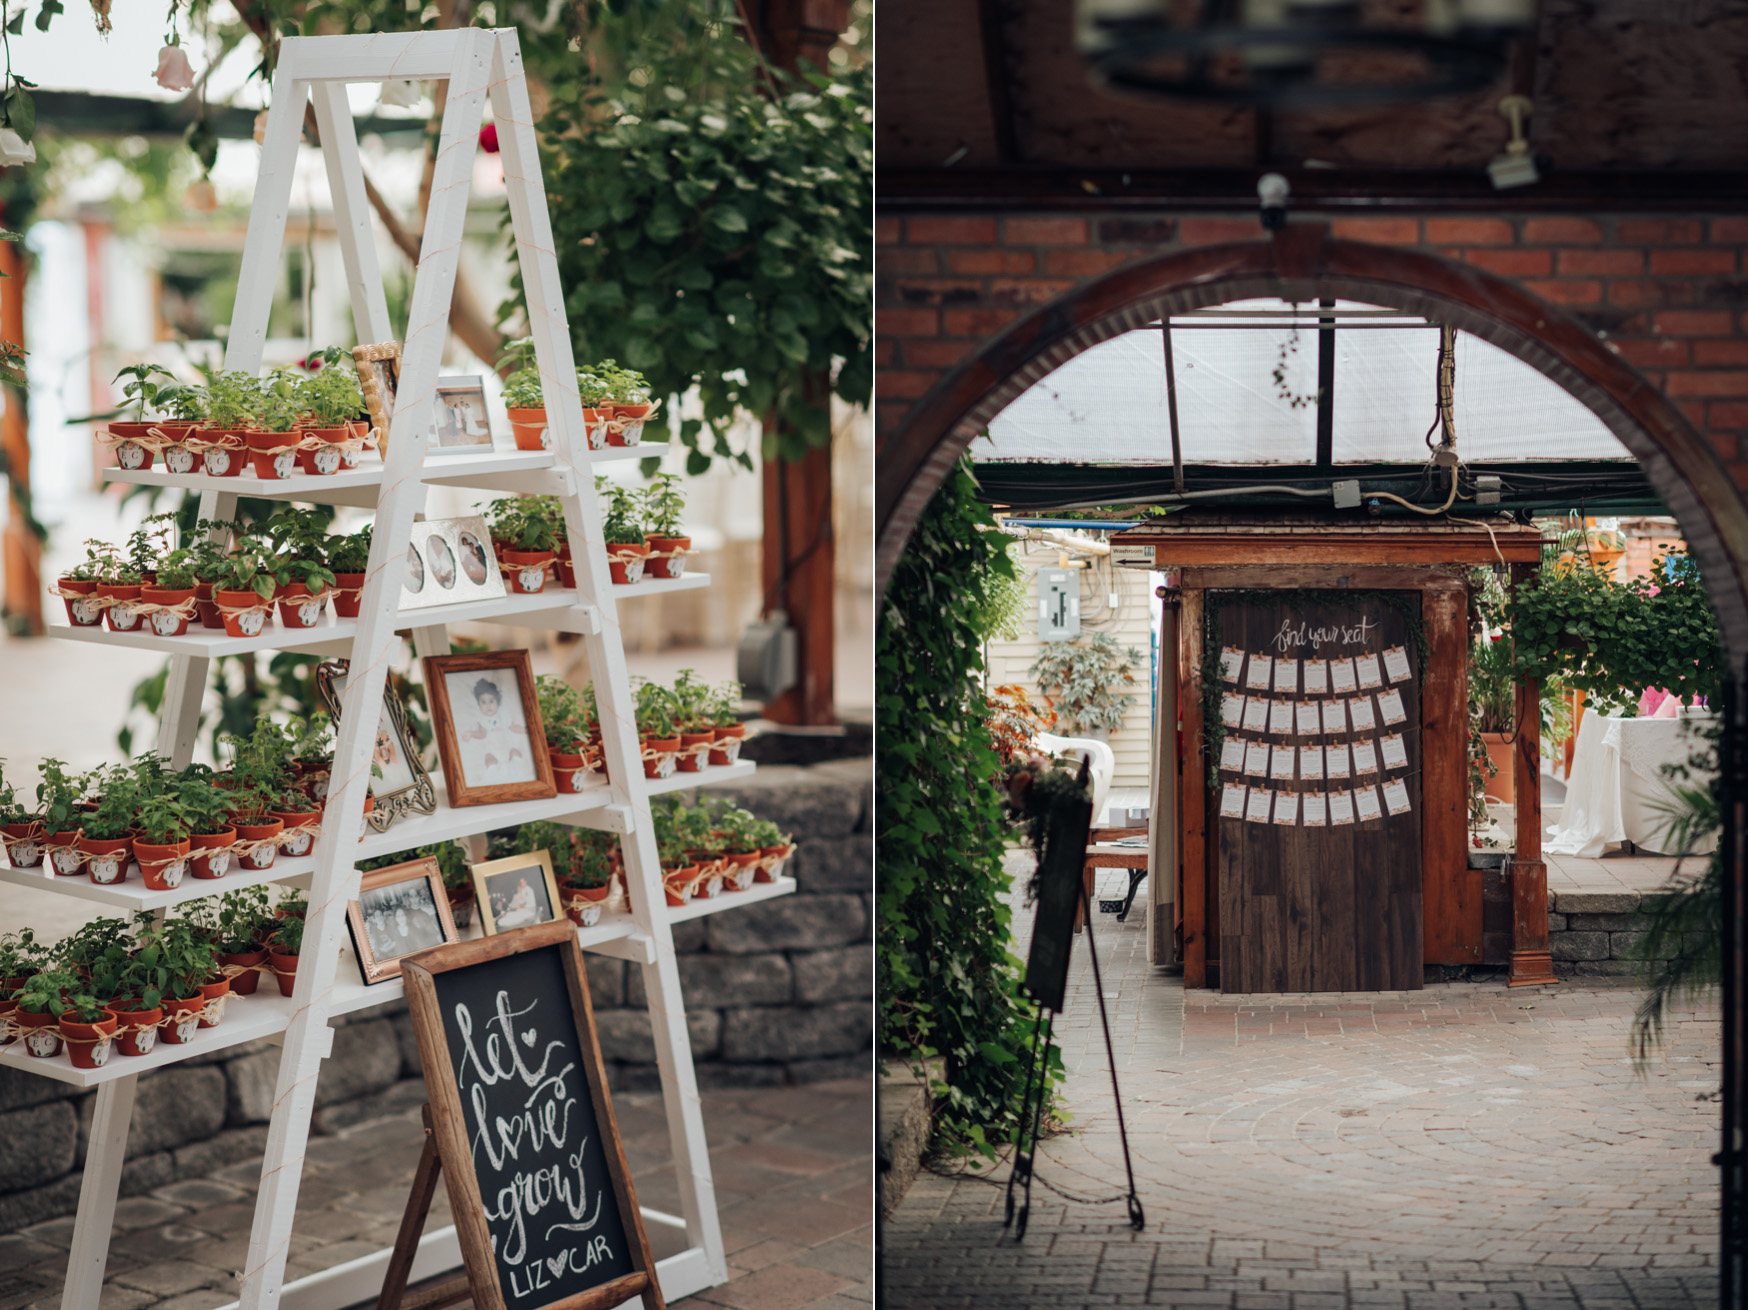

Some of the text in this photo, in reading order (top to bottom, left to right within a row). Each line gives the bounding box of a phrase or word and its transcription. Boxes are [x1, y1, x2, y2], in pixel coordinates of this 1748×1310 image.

[1269, 615, 1379, 652] find your seat
[456, 991, 565, 1089] let
[471, 1063, 576, 1171] love
[482, 1136, 589, 1265] grow
[510, 1235, 614, 1299] LIZ CAR
